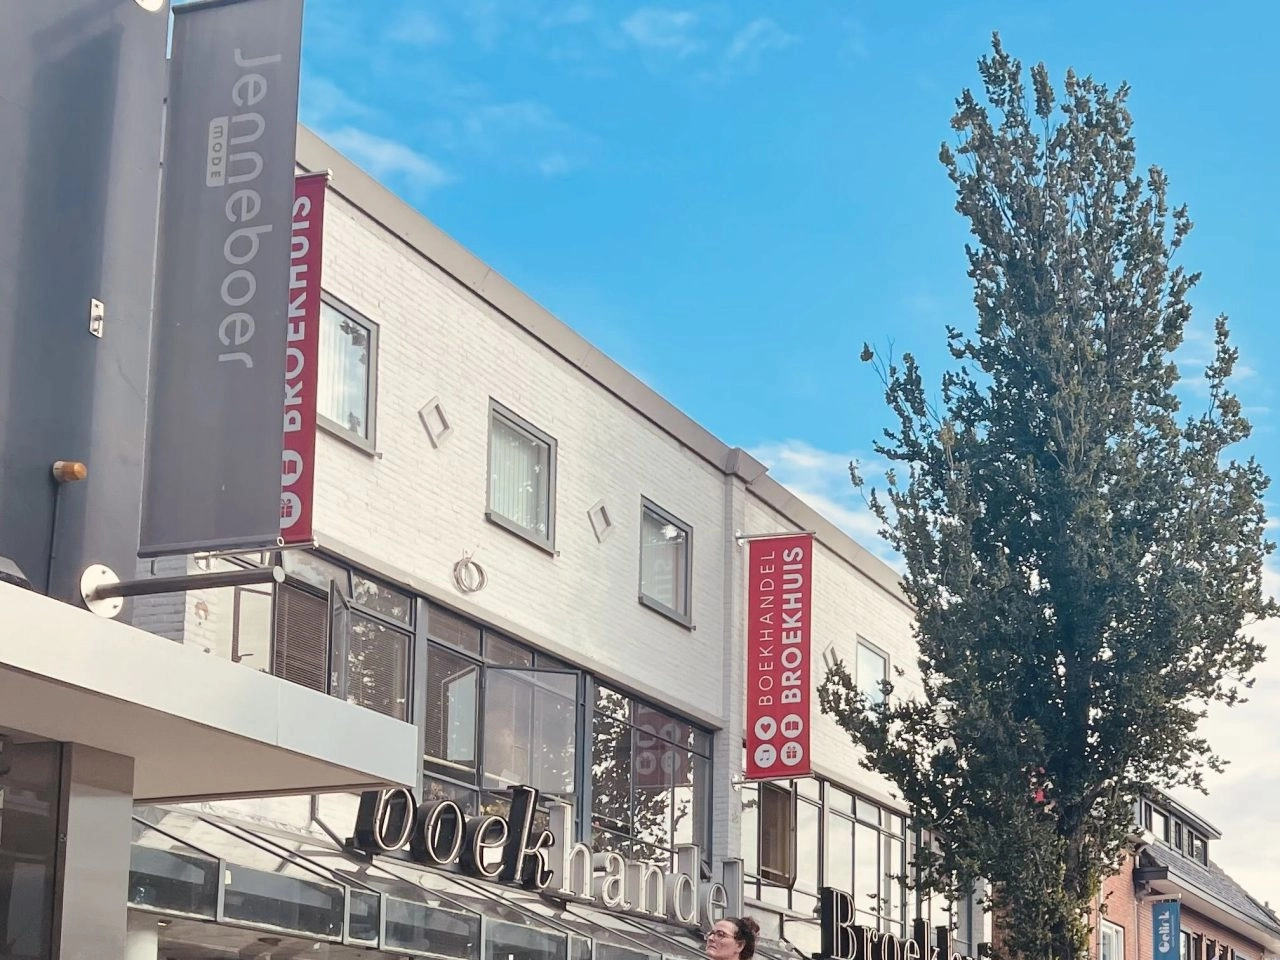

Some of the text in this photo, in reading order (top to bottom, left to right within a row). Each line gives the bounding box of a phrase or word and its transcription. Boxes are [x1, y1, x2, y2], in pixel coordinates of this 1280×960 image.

[209, 124, 224, 179] MODE
[217, 47, 282, 368] Jenneboer
[758, 550, 775, 706] BOEKHANDEL
[780, 546, 803, 704] BROEKHUIS
